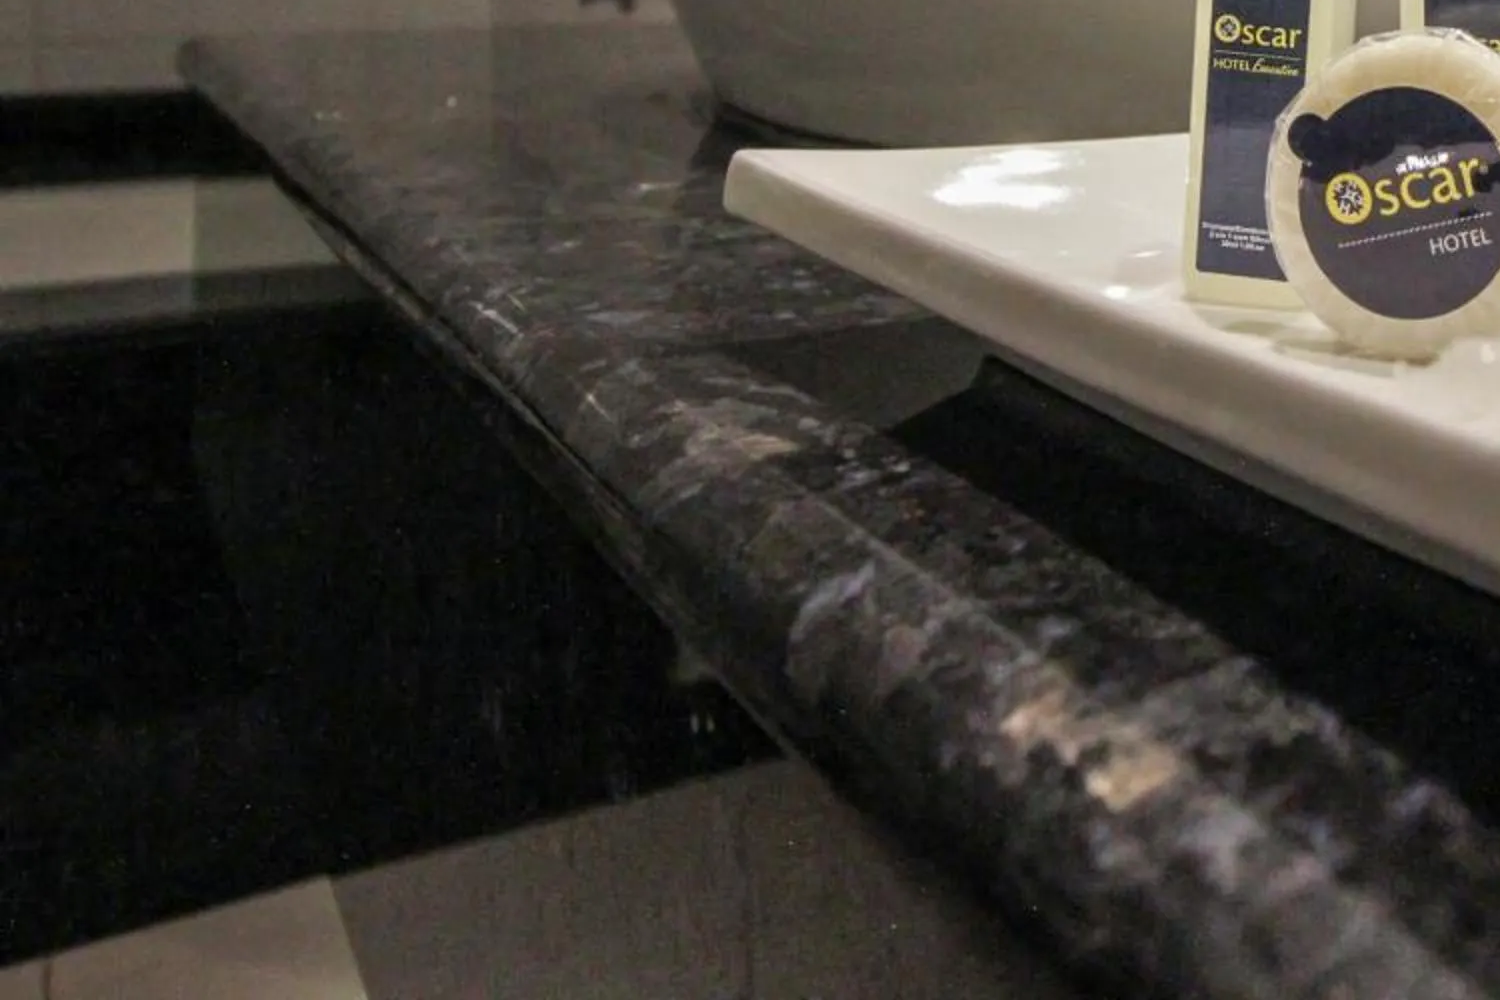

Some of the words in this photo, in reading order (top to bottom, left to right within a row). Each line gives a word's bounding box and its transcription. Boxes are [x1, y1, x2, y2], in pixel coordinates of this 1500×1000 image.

[1214, 13, 1302, 49] Oscar
[1212, 57, 1250, 72] HOTEL
[1325, 157, 1480, 226] Oscar
[1429, 227, 1493, 256] HOTEL
